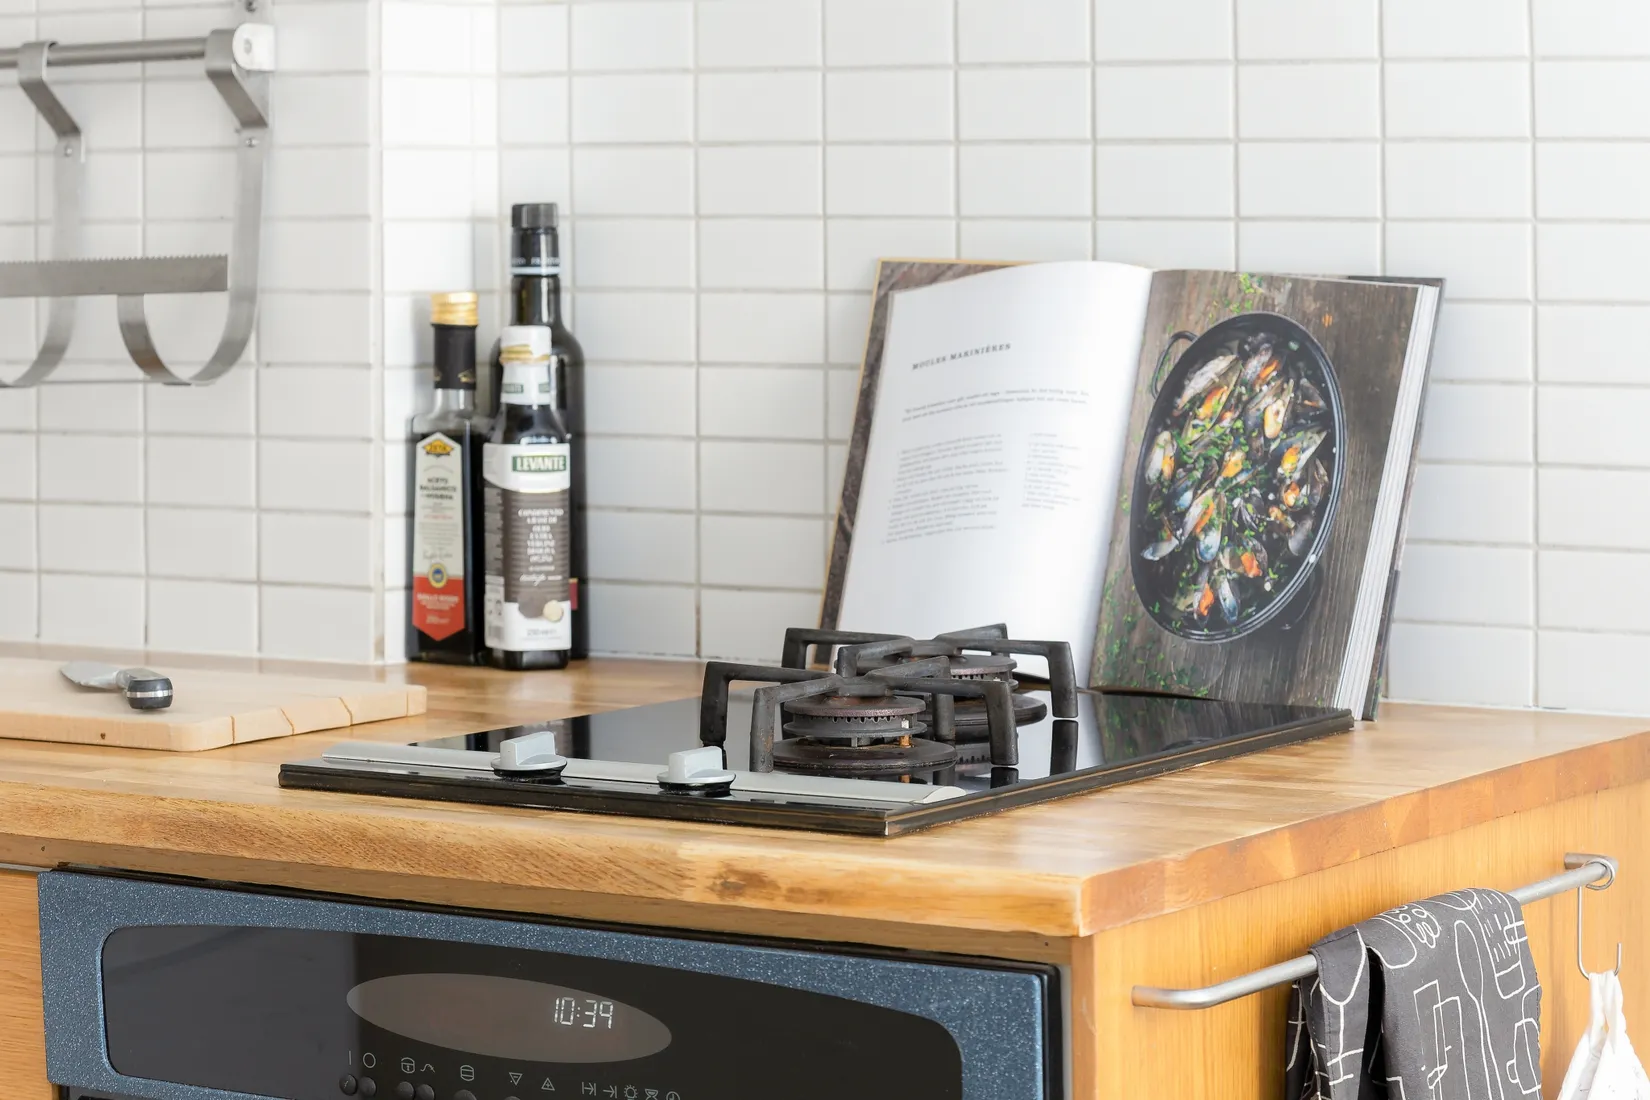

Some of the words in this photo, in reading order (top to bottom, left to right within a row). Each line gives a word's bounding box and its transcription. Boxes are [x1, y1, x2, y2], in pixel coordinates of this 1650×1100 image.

[912, 355, 946, 370] MOULES
[516, 456, 565, 470] LEVANTE
[554, 997, 614, 1029] 10:39
